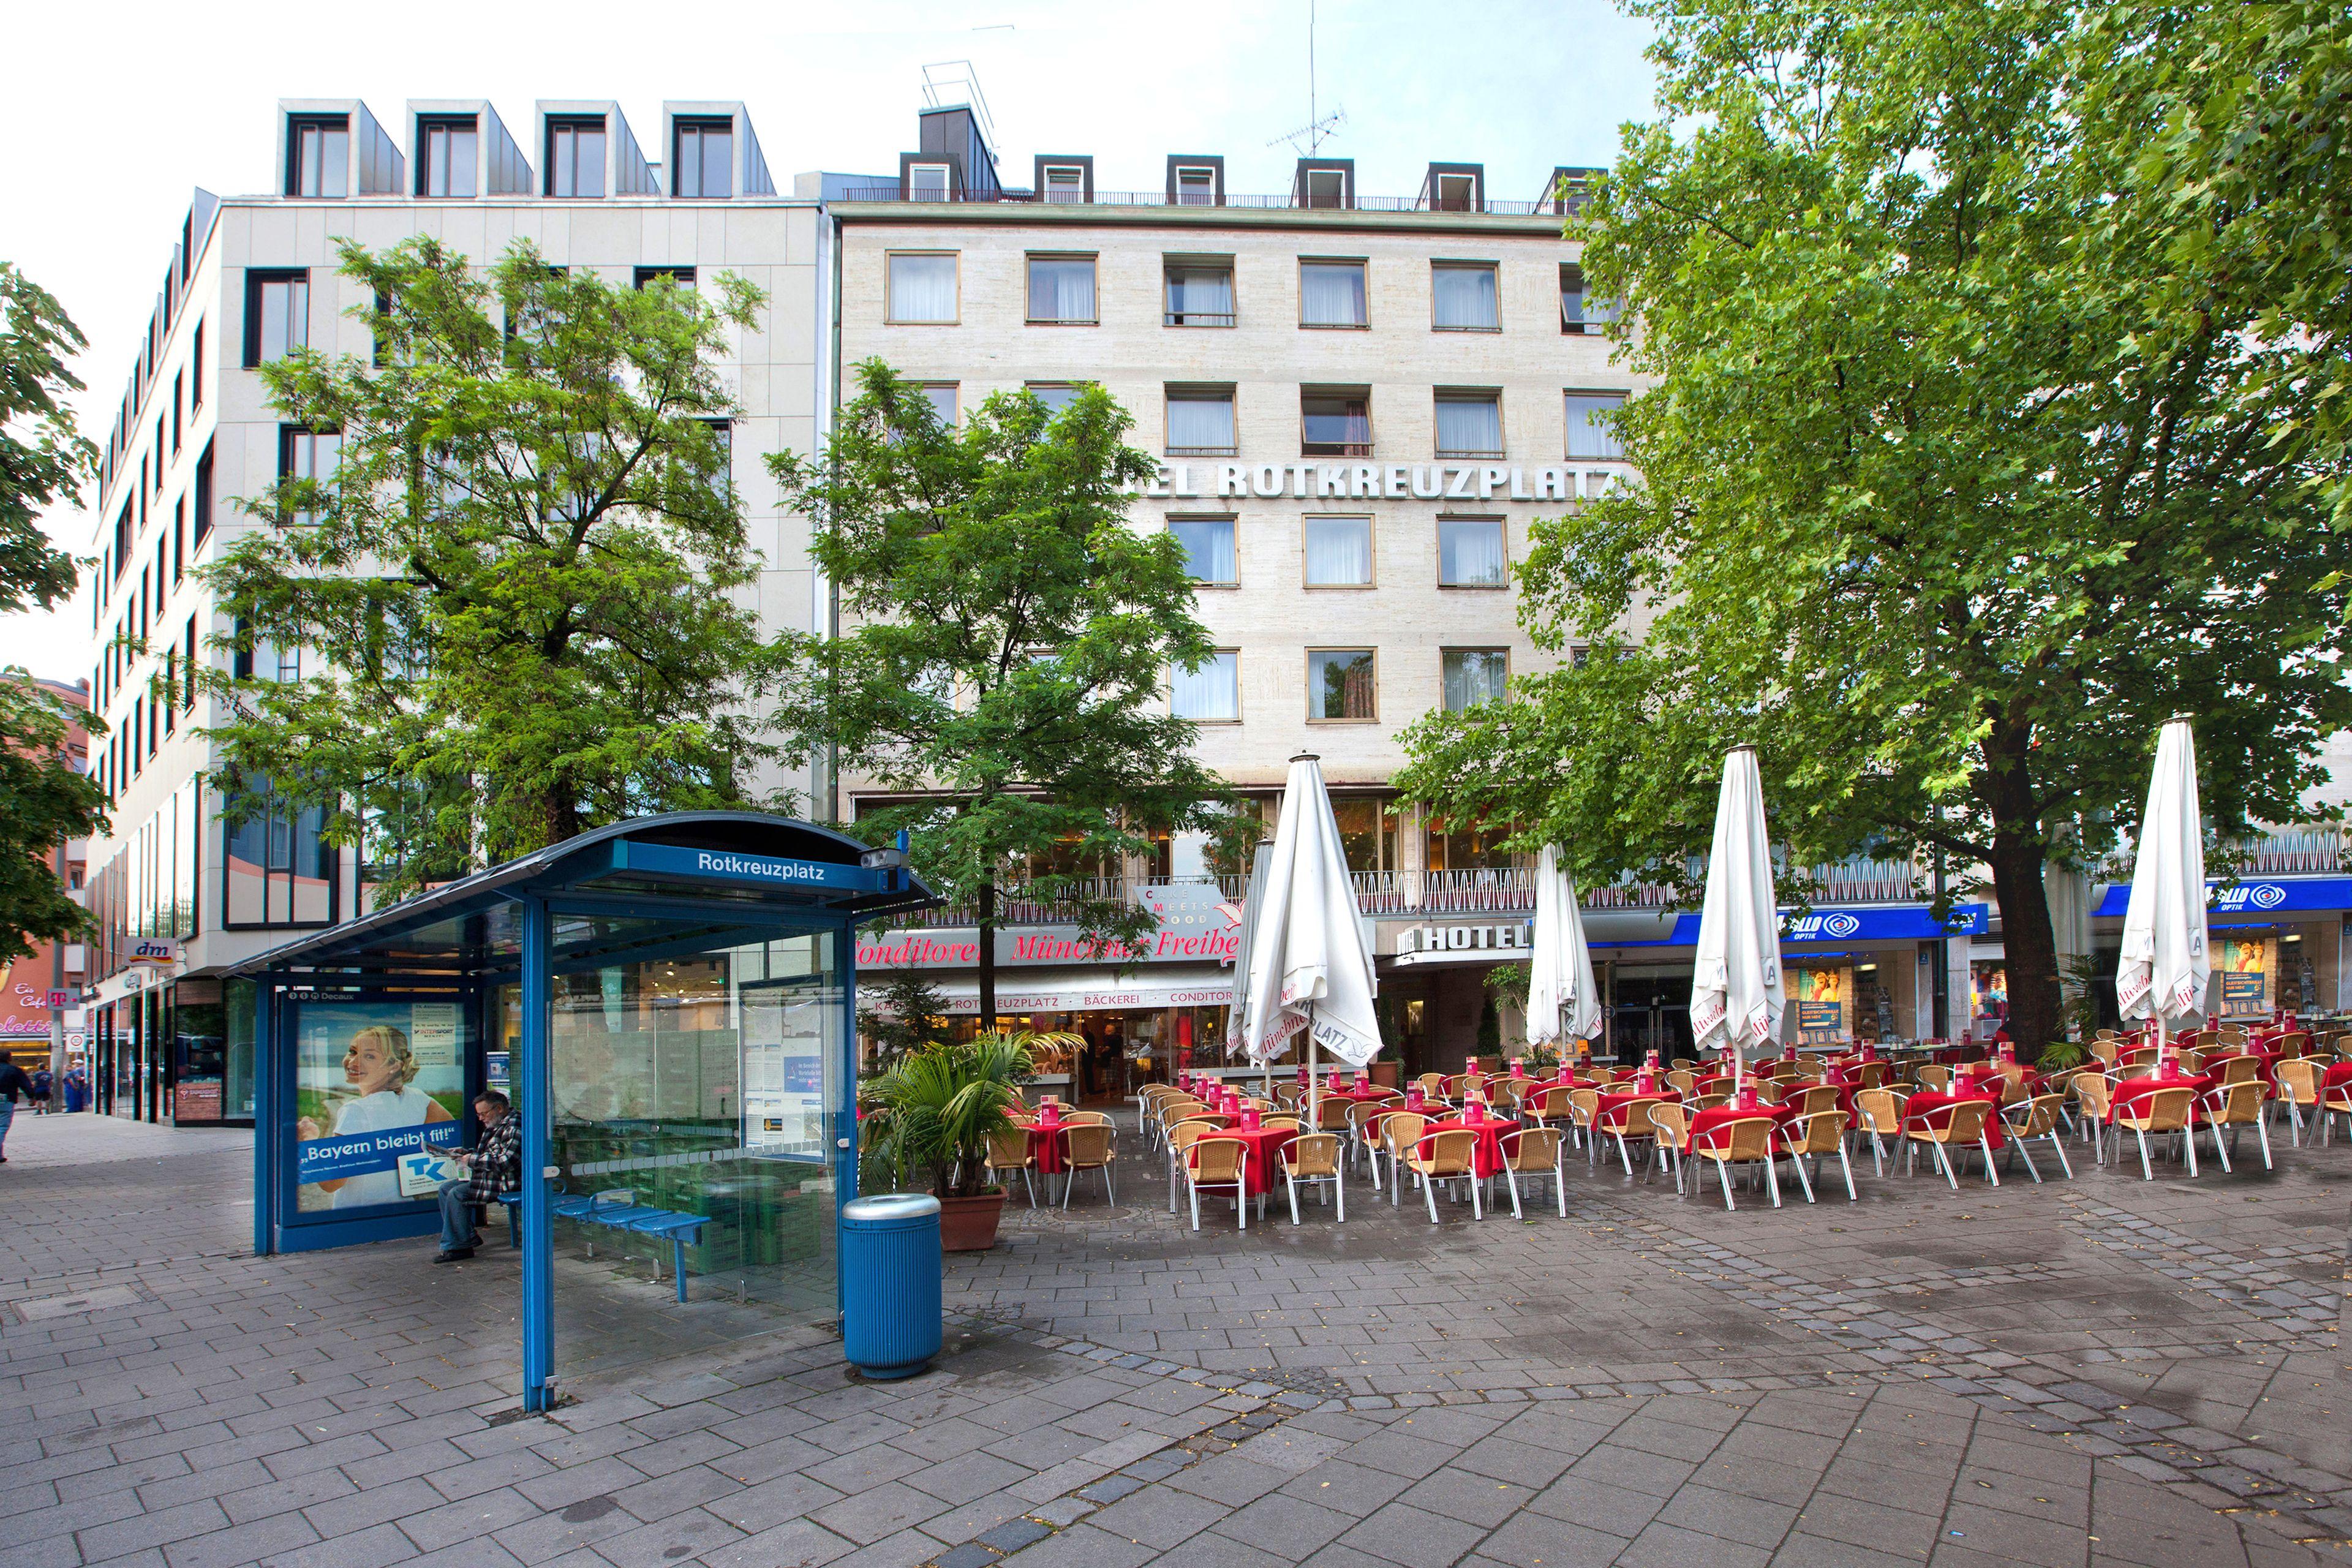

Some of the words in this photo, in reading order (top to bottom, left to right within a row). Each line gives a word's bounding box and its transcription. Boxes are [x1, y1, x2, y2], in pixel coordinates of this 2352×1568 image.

[1218, 463, 1624, 501] ROTKREUZPLATZ
[698, 853, 825, 880] Rotkreuzplatz
[1146, 889, 1188, 899] CAKE
[1154, 902, 1209, 913] MEETS
[135, 942, 168, 956] dm
[1156, 929, 1240, 957] Freihe
[1423, 924, 1530, 950] HOTEL
[956, 997, 1059, 1009] ROTEUZPLATZ
[1084, 993, 1139, 1005] BÄCKEREI
[1170, 991, 1232, 1002] CONDITOR
[300, 1142, 371, 1164] „Bayern
[376, 1131, 425, 1150] bleibt
[406, 1157, 448, 1182] TK
